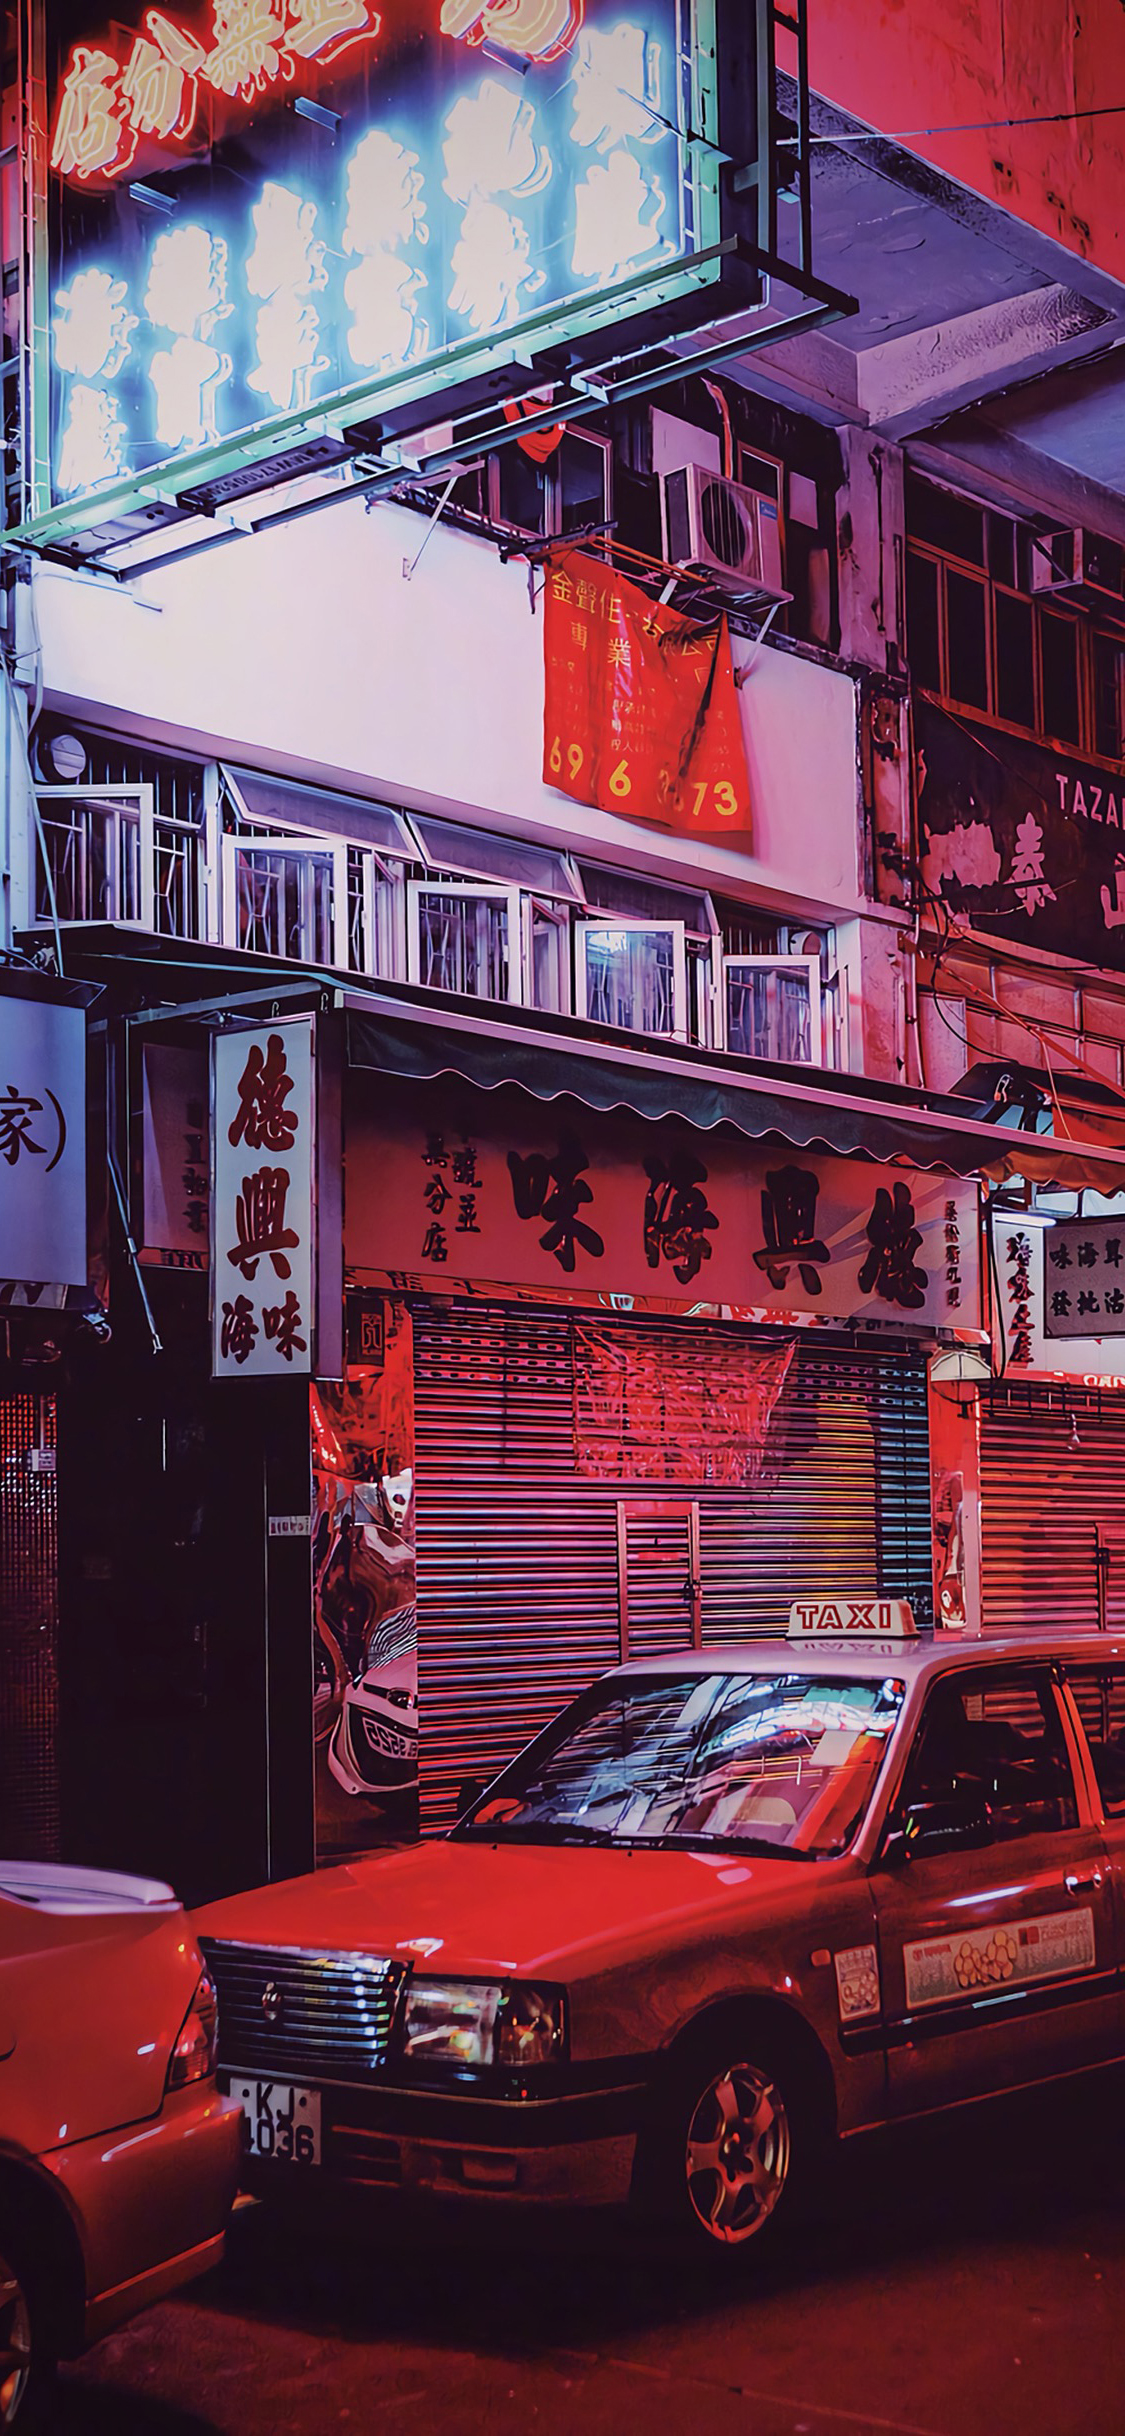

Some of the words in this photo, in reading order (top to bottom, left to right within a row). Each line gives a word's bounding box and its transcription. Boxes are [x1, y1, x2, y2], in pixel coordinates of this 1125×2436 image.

[1055, 774, 1125, 830] TAZA
[797, 1604, 890, 1630] TAXI
[256, 2082, 295, 2121] KJ
